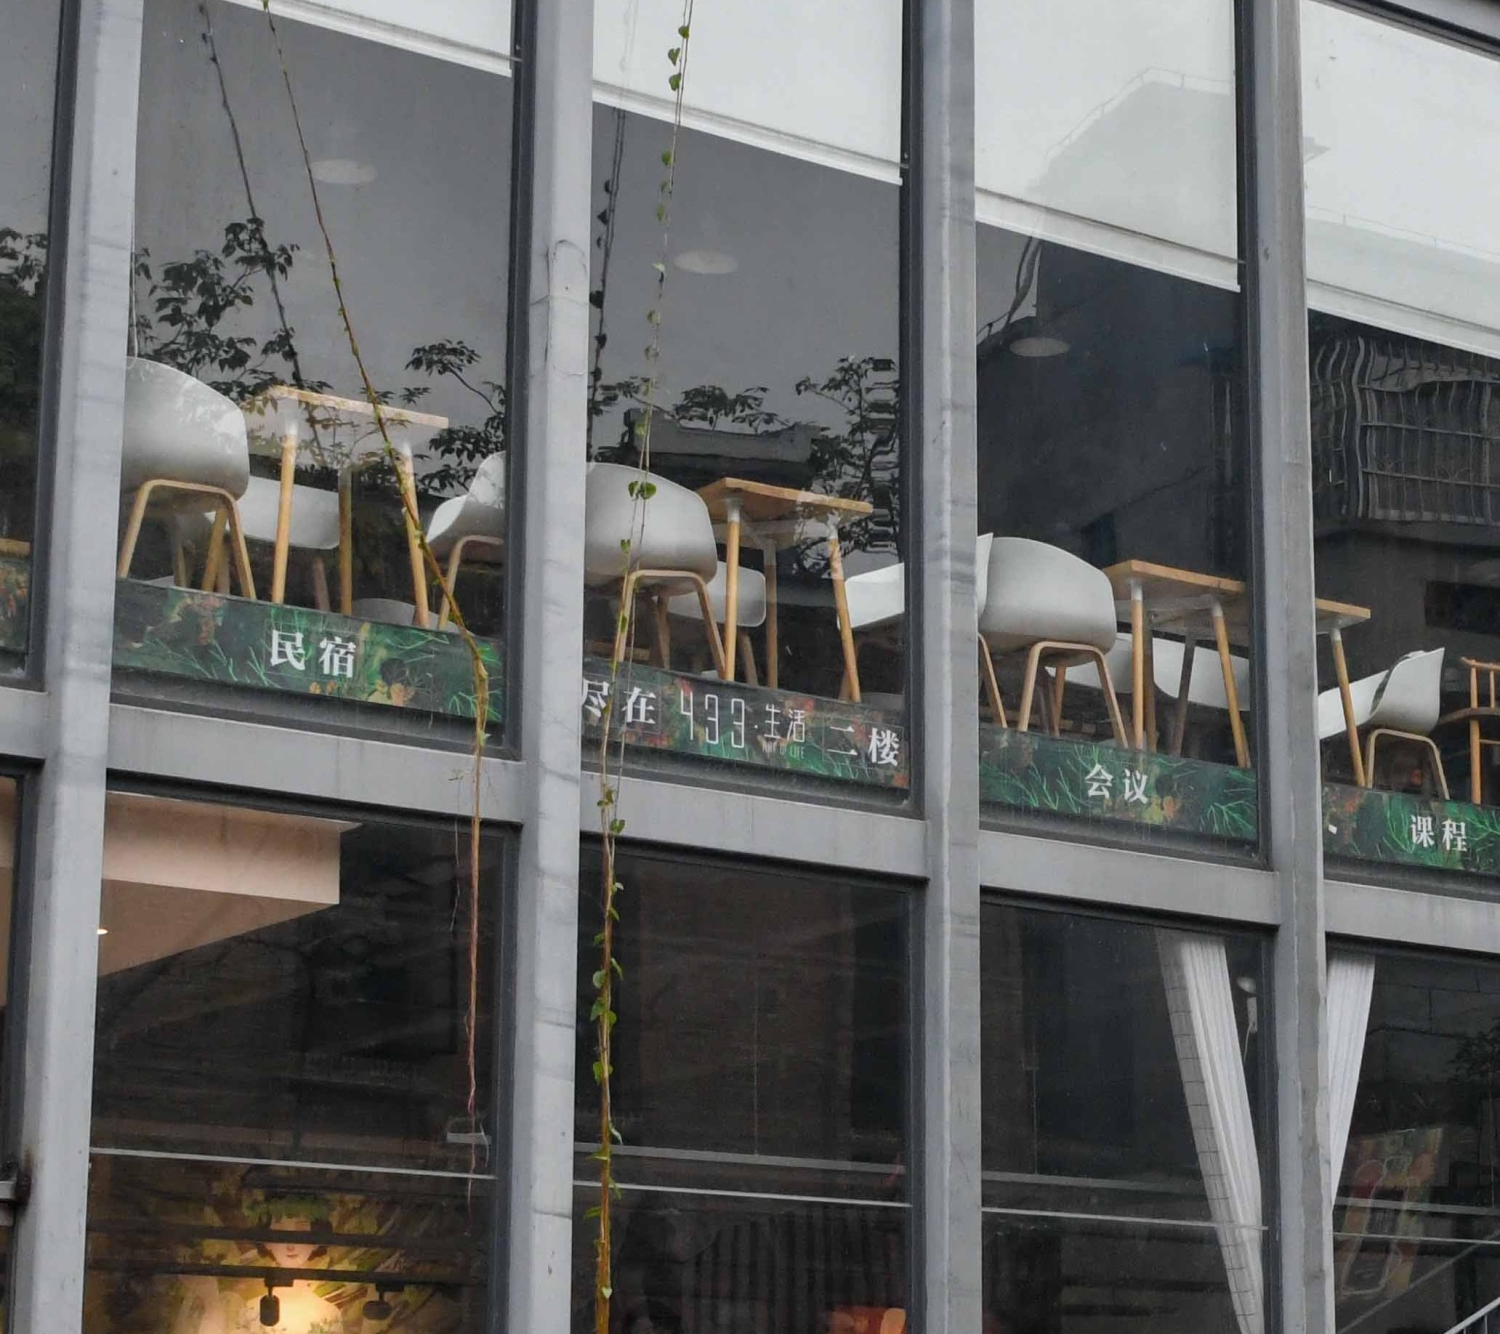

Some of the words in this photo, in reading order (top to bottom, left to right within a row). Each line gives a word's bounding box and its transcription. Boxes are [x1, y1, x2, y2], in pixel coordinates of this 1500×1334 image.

[269, 629, 357, 678] 民宿
[680, 689, 806, 749] 433·生活
[827, 724, 900, 767] 二楼
[1084, 764, 1150, 804] 会议
[1410, 813, 1468, 852] 课程
